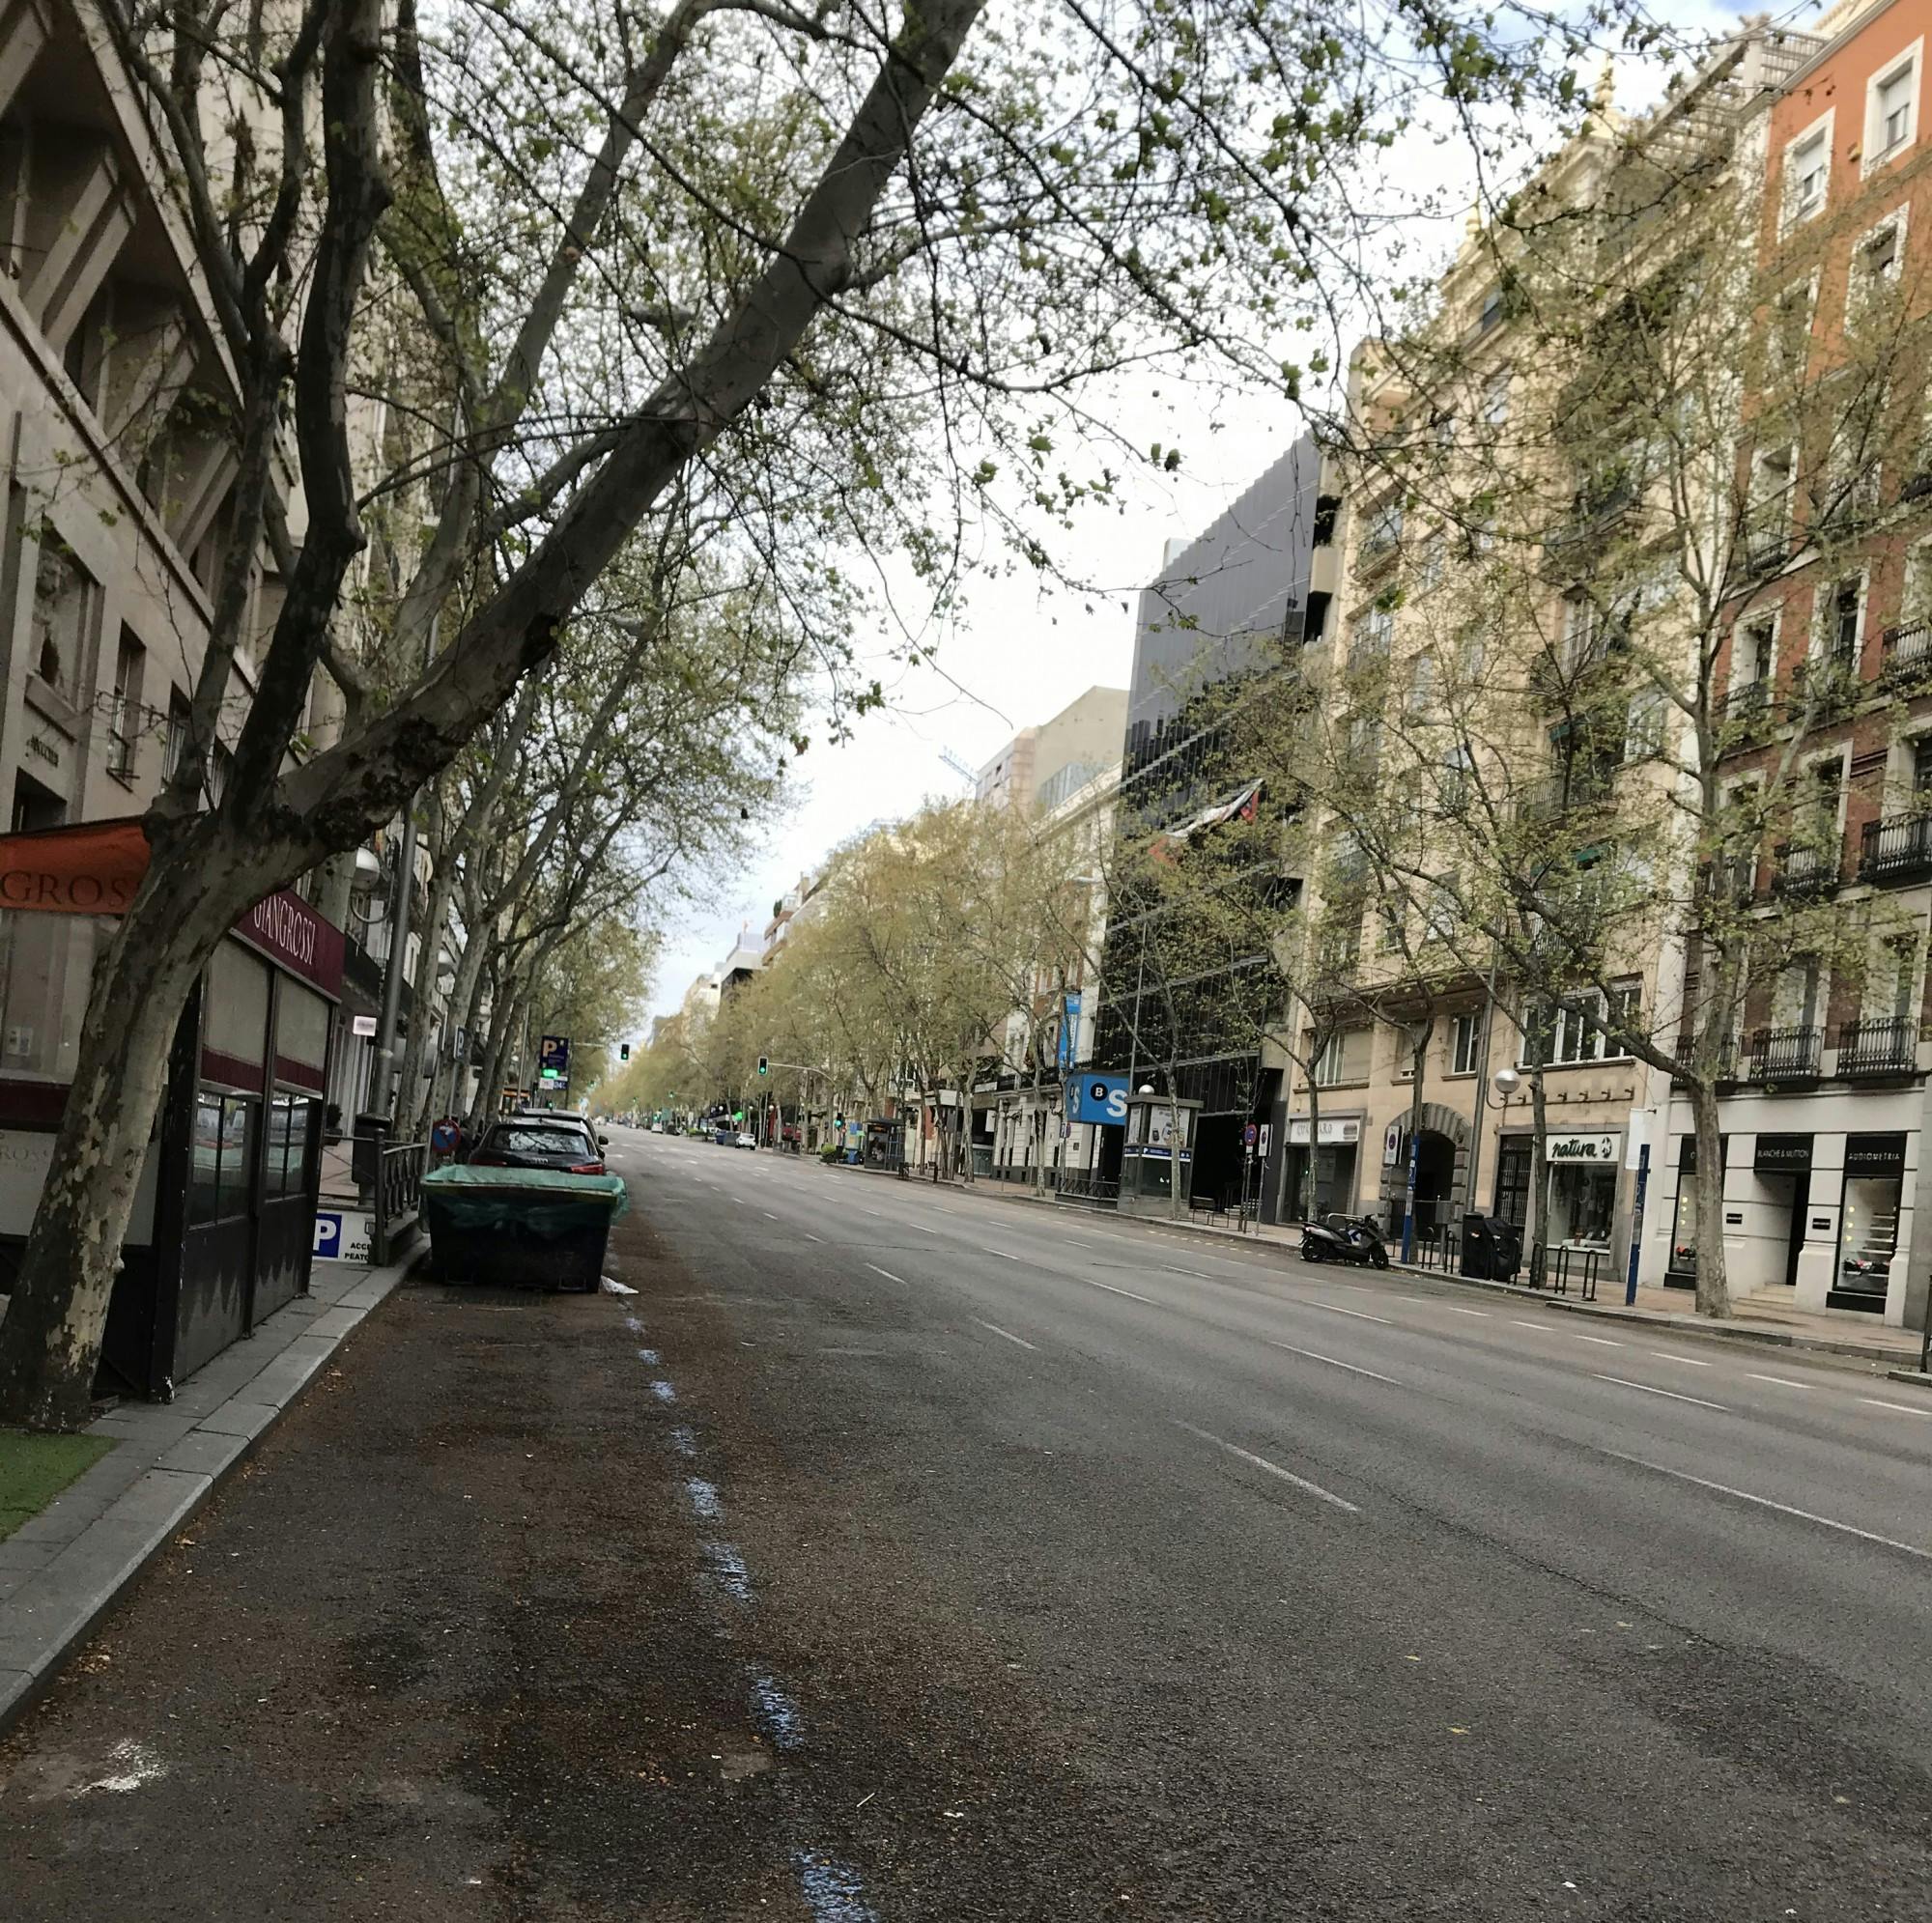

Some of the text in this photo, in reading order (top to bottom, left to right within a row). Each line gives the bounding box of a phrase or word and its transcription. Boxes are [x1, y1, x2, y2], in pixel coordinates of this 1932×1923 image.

[1, 870, 139, 906] GROS
[543, 1039, 557, 1058] P
[1106, 1089, 1128, 1117] S
[1551, 1139, 1598, 1158] natura
[313, 1218, 337, 1251] P
